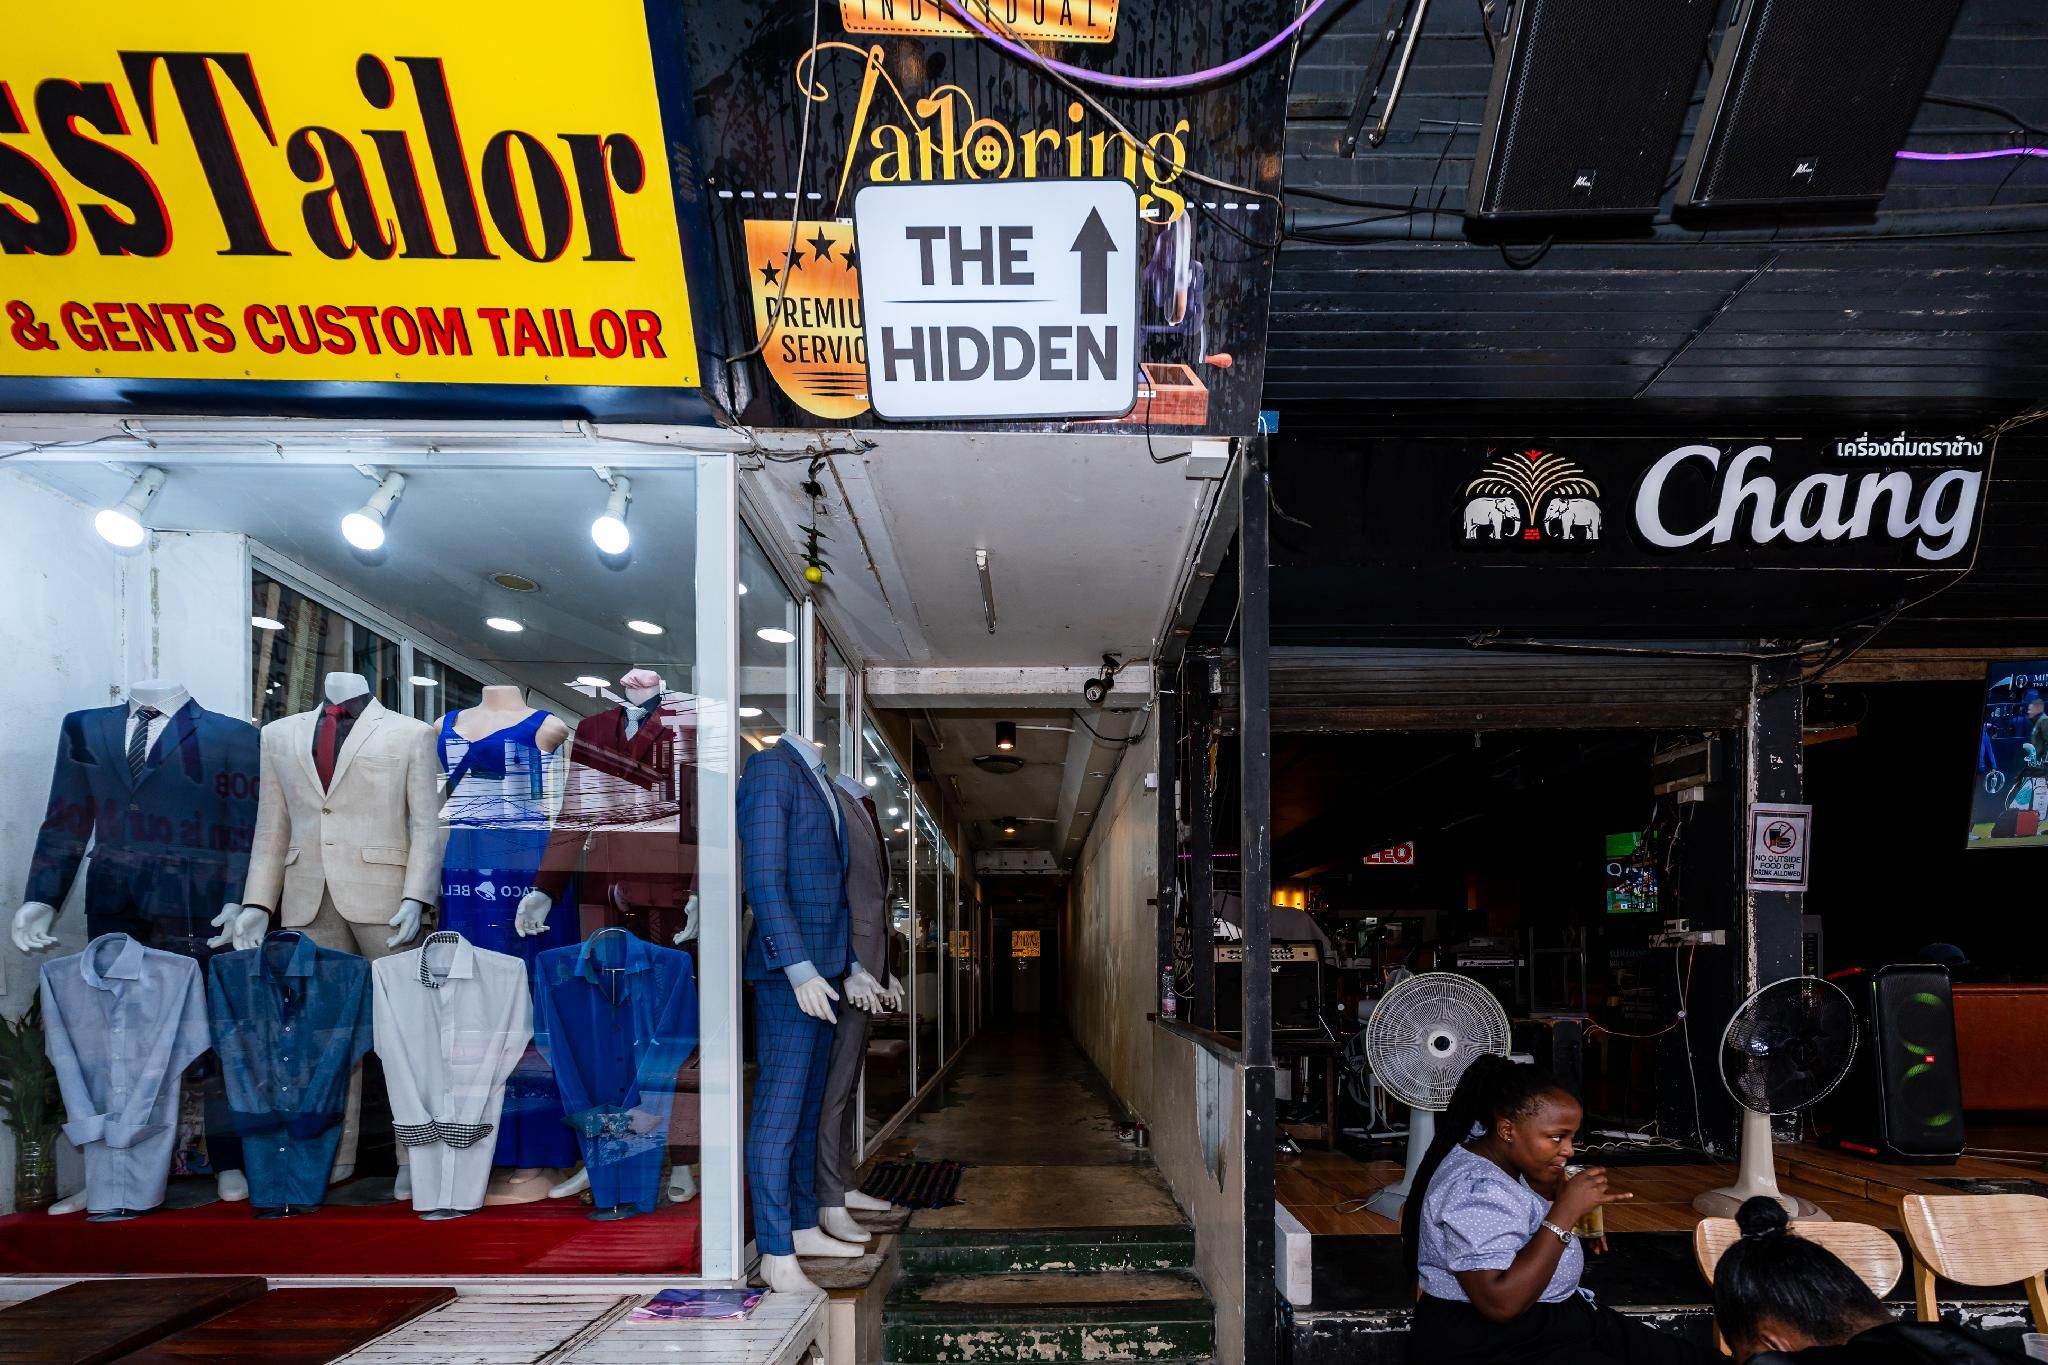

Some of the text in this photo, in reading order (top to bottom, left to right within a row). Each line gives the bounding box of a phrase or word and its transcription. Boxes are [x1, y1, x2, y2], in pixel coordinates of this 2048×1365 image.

[905, 225, 1035, 286] THE
[9, 300, 668, 360] & GENTS CUSTOM TAILOR
[765, 296, 863, 329] PREMIU
[781, 334, 866, 365] SERVIC
[881, 325, 1119, 383] HIDDEN
[1837, 431, 1984, 457] เครื่องดื่มตราช้าง
[1634, 444, 1983, 561] Chang
[1768, 855, 1801, 864] OUTSIDE
